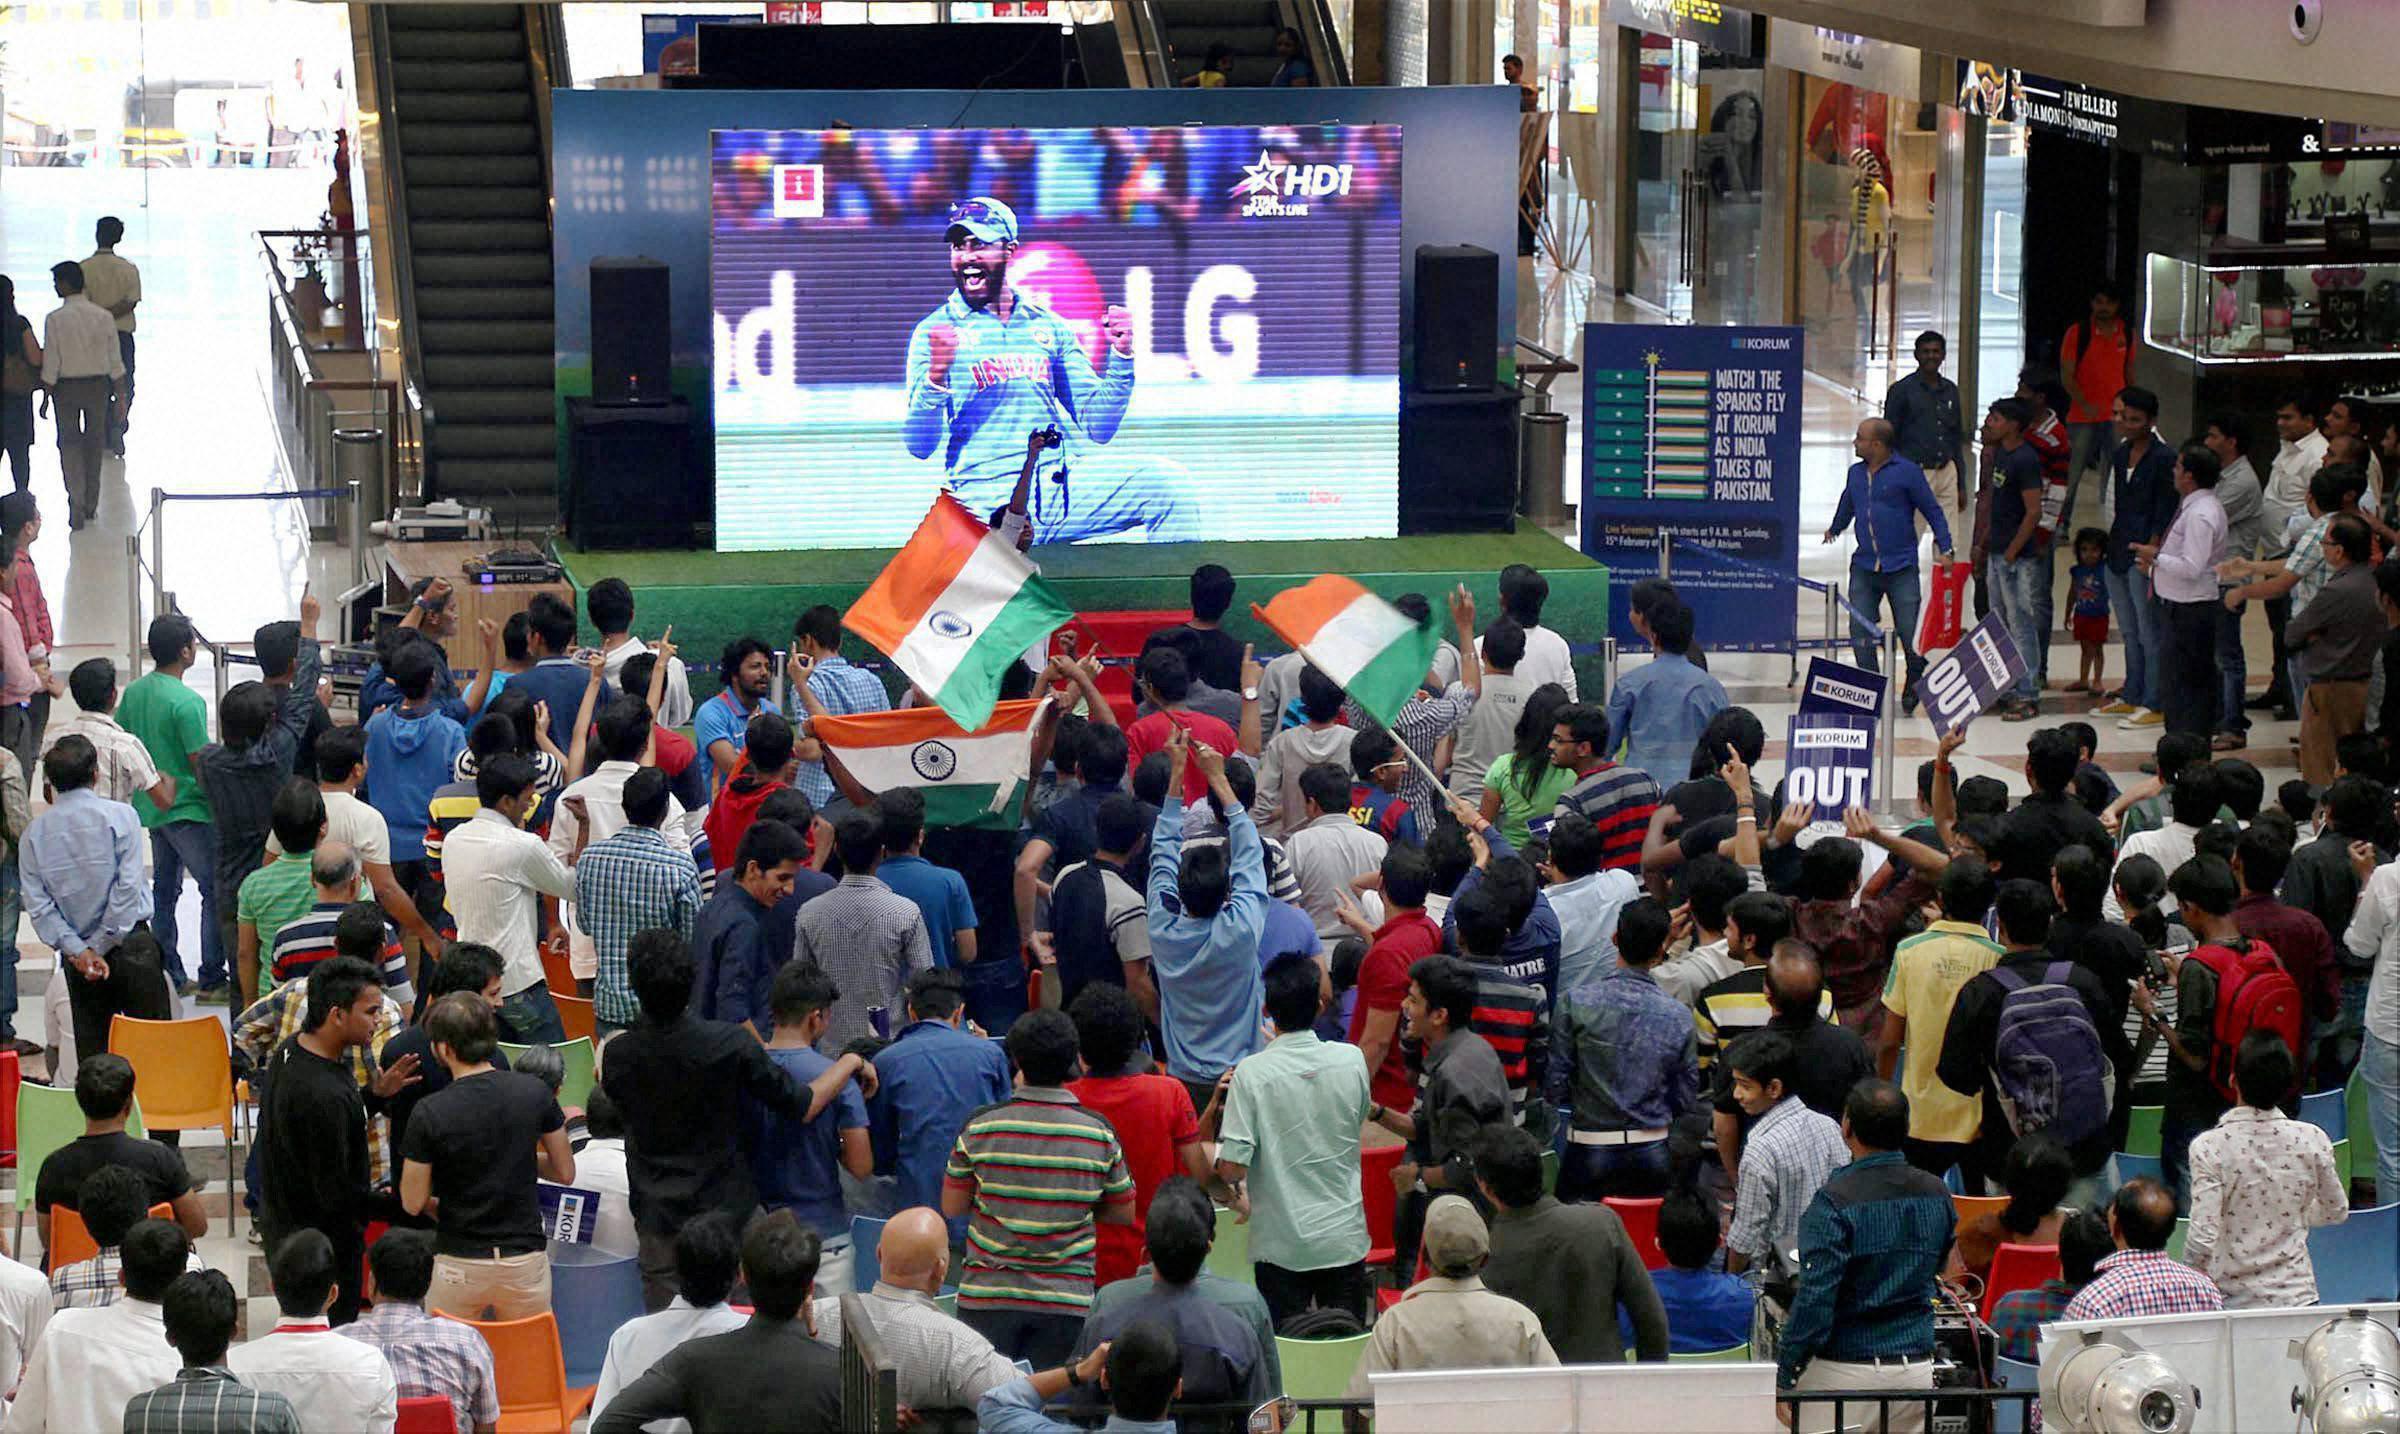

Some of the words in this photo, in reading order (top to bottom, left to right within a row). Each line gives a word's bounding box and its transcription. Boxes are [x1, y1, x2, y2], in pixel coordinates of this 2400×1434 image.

[2063, 89, 2118, 118] JEWELLERS
[2023, 101, 2072, 128] DIAMONDS
[2302, 134, 2321, 153] &
[1283, 164, 1353, 196] HD1
[1242, 203, 1286, 217] SPORTS
[1285, 204, 1309, 216] LIVE
[1125, 264, 1260, 386] LG
[1747, 338, 1790, 350] KORUM
[1716, 369, 1755, 390] WATCH
[1760, 370, 1782, 390] THE
[1716, 392, 1762, 412] SPARKS
[1766, 392, 1786, 412] FLY
[1715, 414, 1729, 434] AT
[1733, 415, 1776, 435] KORUM
[1714, 436, 1730, 457] AS
[1734, 436, 1766, 457] INDIA
[1715, 458, 1750, 479] TAKES
[1754, 459, 1772, 479] ON
[1714, 480, 1774, 502] PAKISTAN.
[1619, 535, 1650, 549] February
[1708, 526, 1715, 537] 9
[1733, 529, 1742, 537] on
[1981, 643, 2008, 681] KORUM
[1830, 685, 1872, 705] KORUM
[1927, 656, 1981, 729] OUT
[1815, 733, 1861, 744] KORUM
[1788, 766, 1869, 808] OUT
